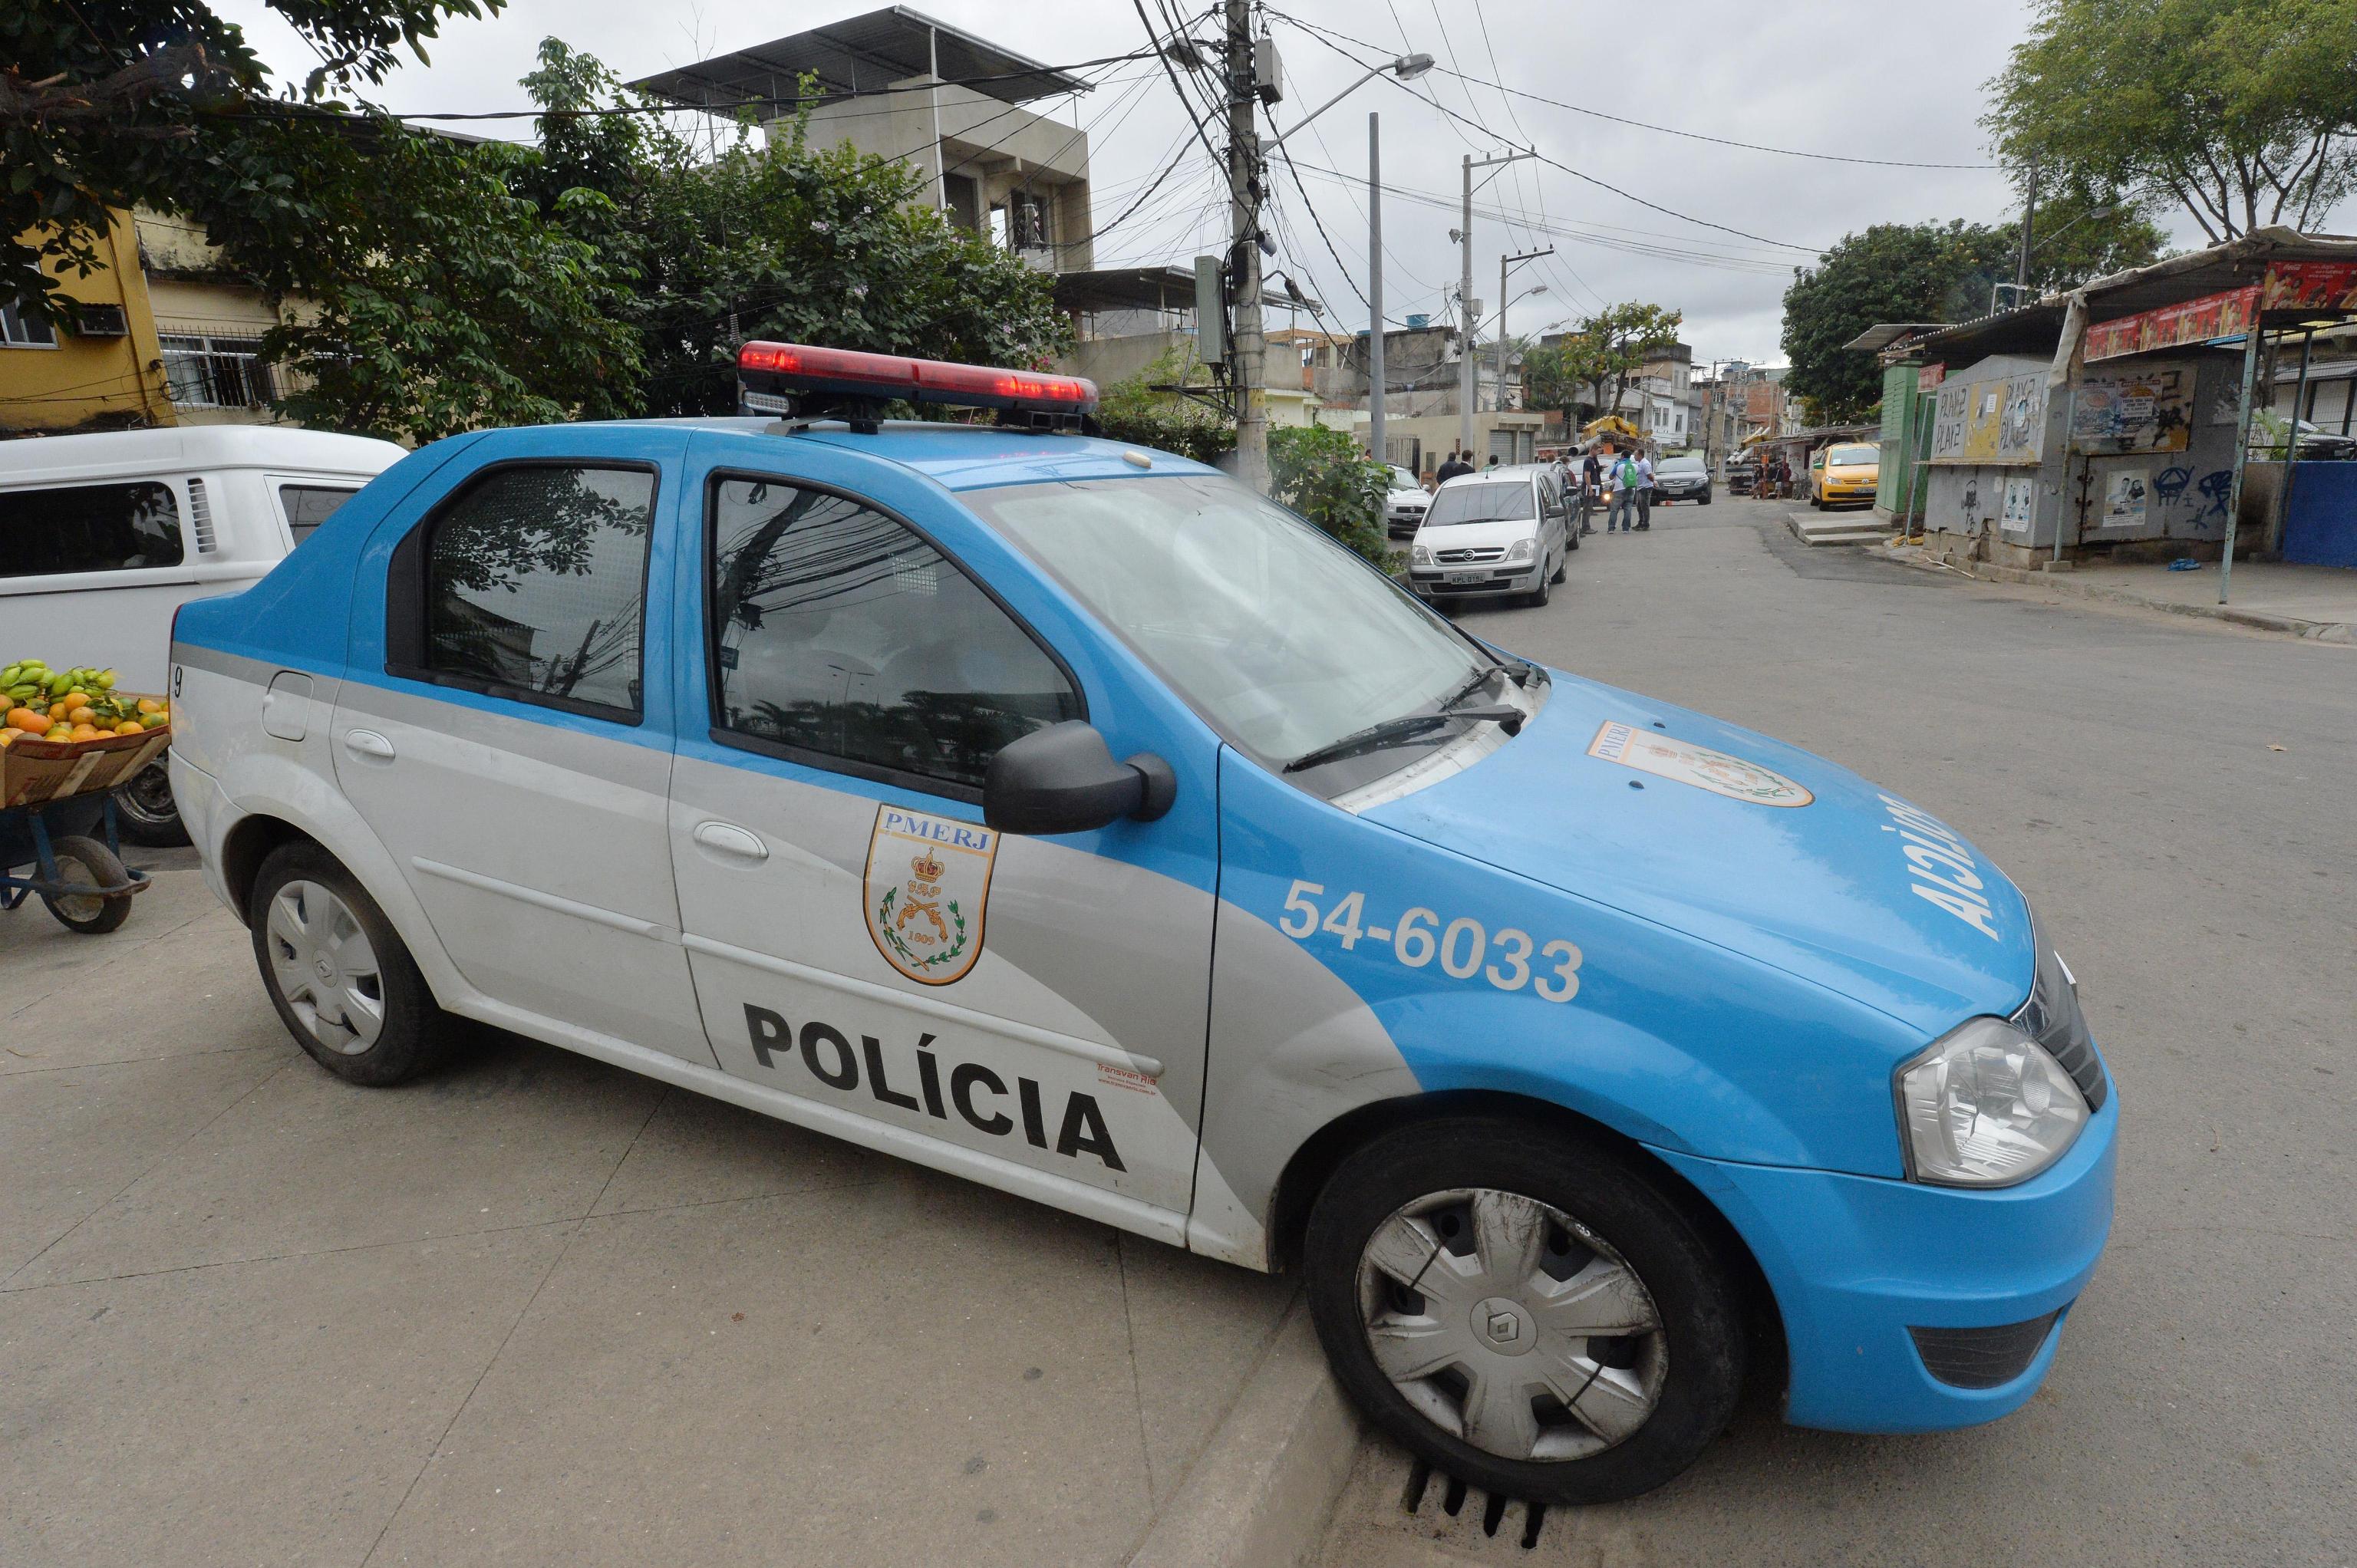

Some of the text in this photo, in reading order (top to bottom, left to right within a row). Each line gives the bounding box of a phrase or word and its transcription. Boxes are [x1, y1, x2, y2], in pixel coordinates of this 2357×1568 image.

[1598, 724, 1630, 759] PMERJ
[884, 812, 990, 850] PMERJ
[908, 931, 935, 945] 1809
[1279, 879, 1584, 1003] 54-6033
[743, 1003, 1128, 1173] POLÍCIA
[1097, 1062, 1139, 1079] Transvan
